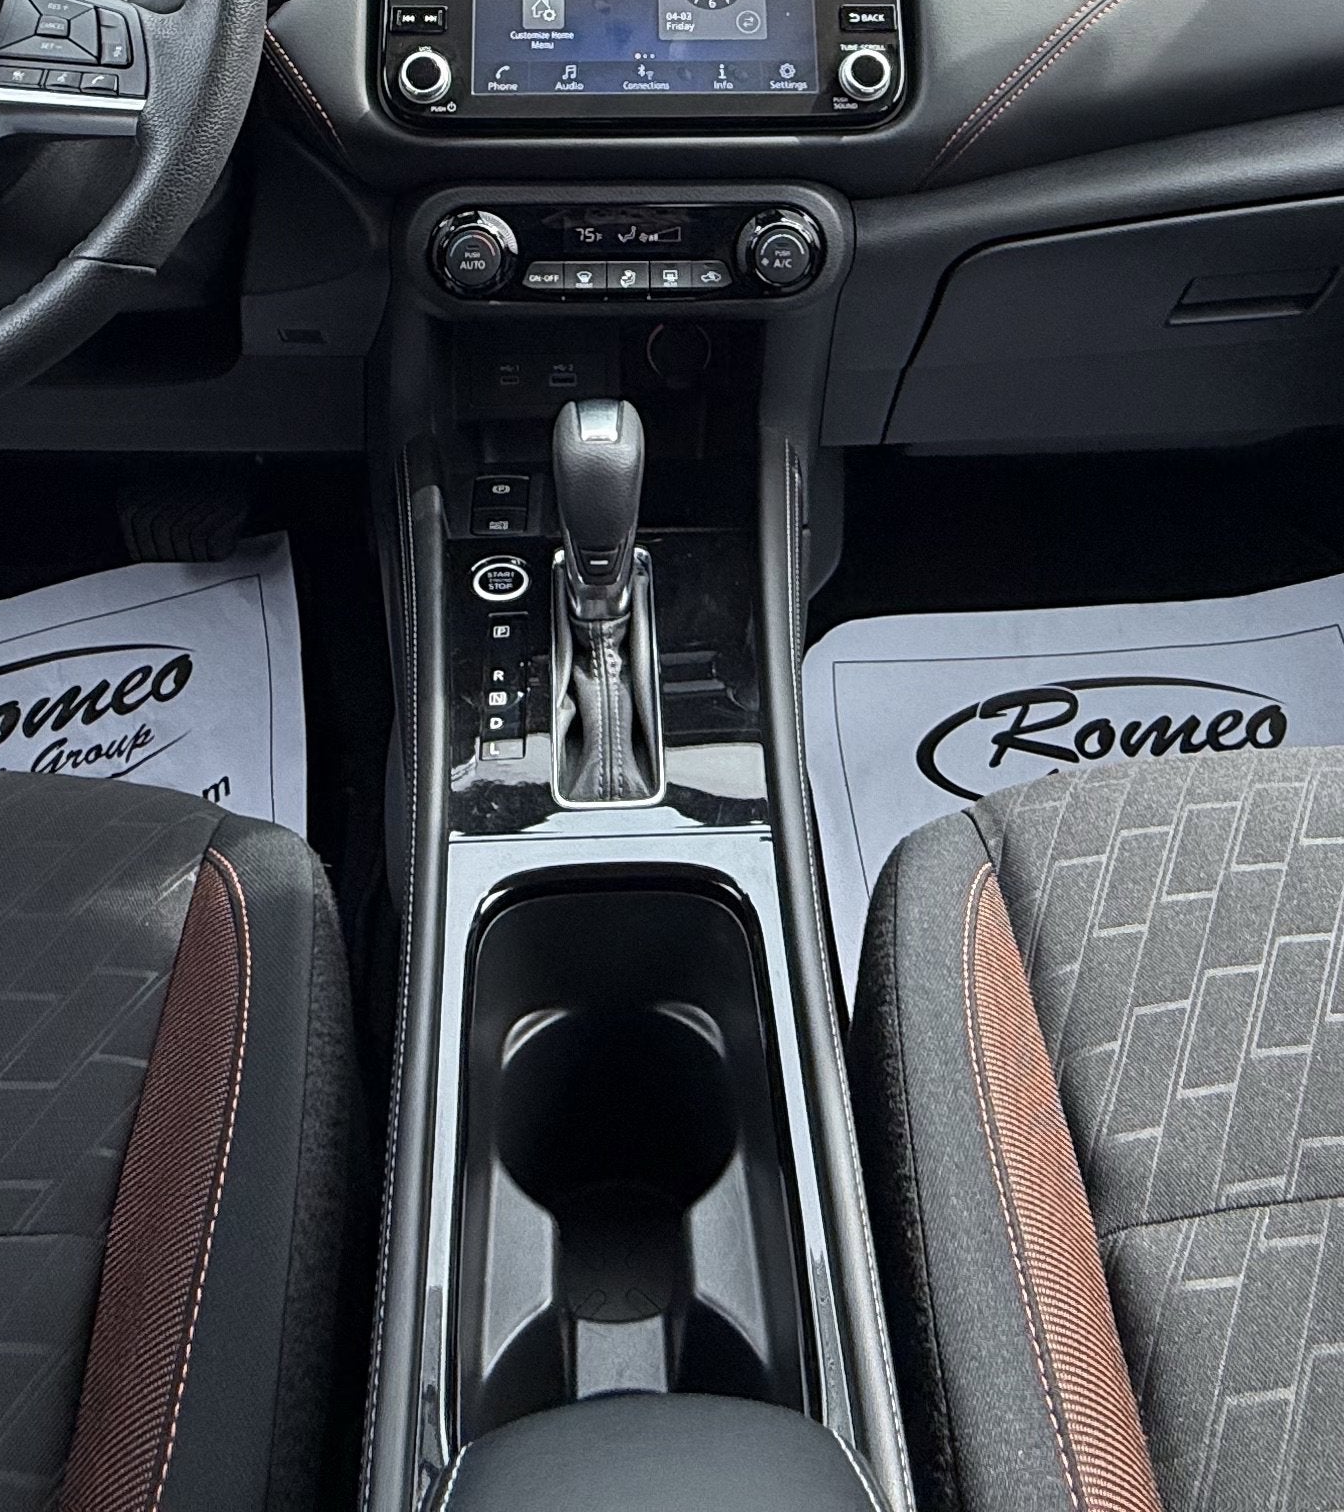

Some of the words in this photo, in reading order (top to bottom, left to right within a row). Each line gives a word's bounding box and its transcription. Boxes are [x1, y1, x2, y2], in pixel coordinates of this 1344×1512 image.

[861, 14, 885, 22] BACK
[665, 21, 695, 32] Friday
[510, 30, 550, 39] Customize
[551, 31, 575, 39] Home
[531, 40, 555, 50] Menu
[487, 81, 519, 91] Phone
[555, 81, 585, 90] Audio
[622, 80, 670, 90] Connections
[713, 80, 734, 89] Info
[769, 79, 808, 91] Settings
[459, 259, 486, 270] AUTO
[773, 258, 793, 269] A/C
[492, 669, 505, 682] R
[489, 717, 504, 730] D
[979, 686, 1289, 769] Romeo
[30, 723, 156, 774] Group
[489, 742, 500, 755] L
